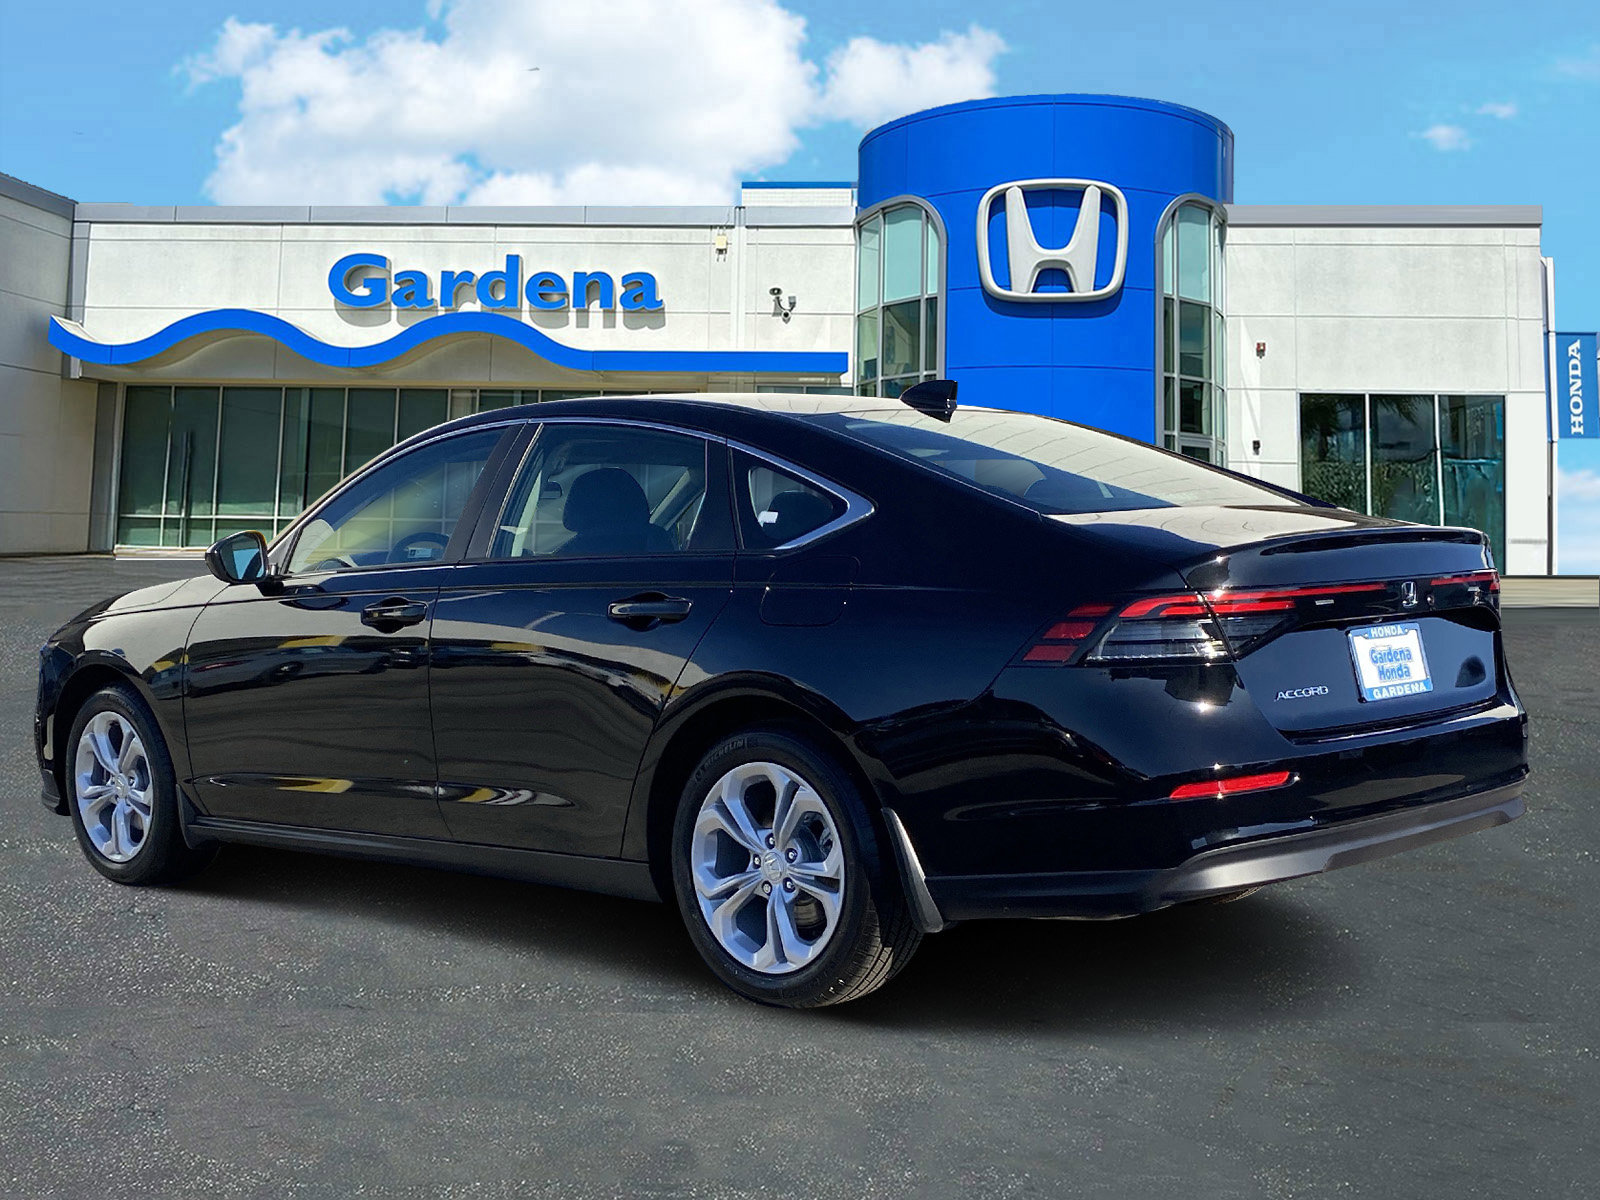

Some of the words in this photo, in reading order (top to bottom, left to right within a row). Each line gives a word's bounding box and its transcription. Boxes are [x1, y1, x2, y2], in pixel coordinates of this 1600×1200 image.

[328, 252, 664, 310] Gardena
[1567, 339, 1584, 435] HONDA
[1371, 624, 1403, 637] HONDA
[1370, 646, 1412, 664] Gardena
[1378, 663, 1411, 680] Honda
[1275, 685, 1329, 701] ACCORD
[1373, 681, 1427, 699] GARDENA
